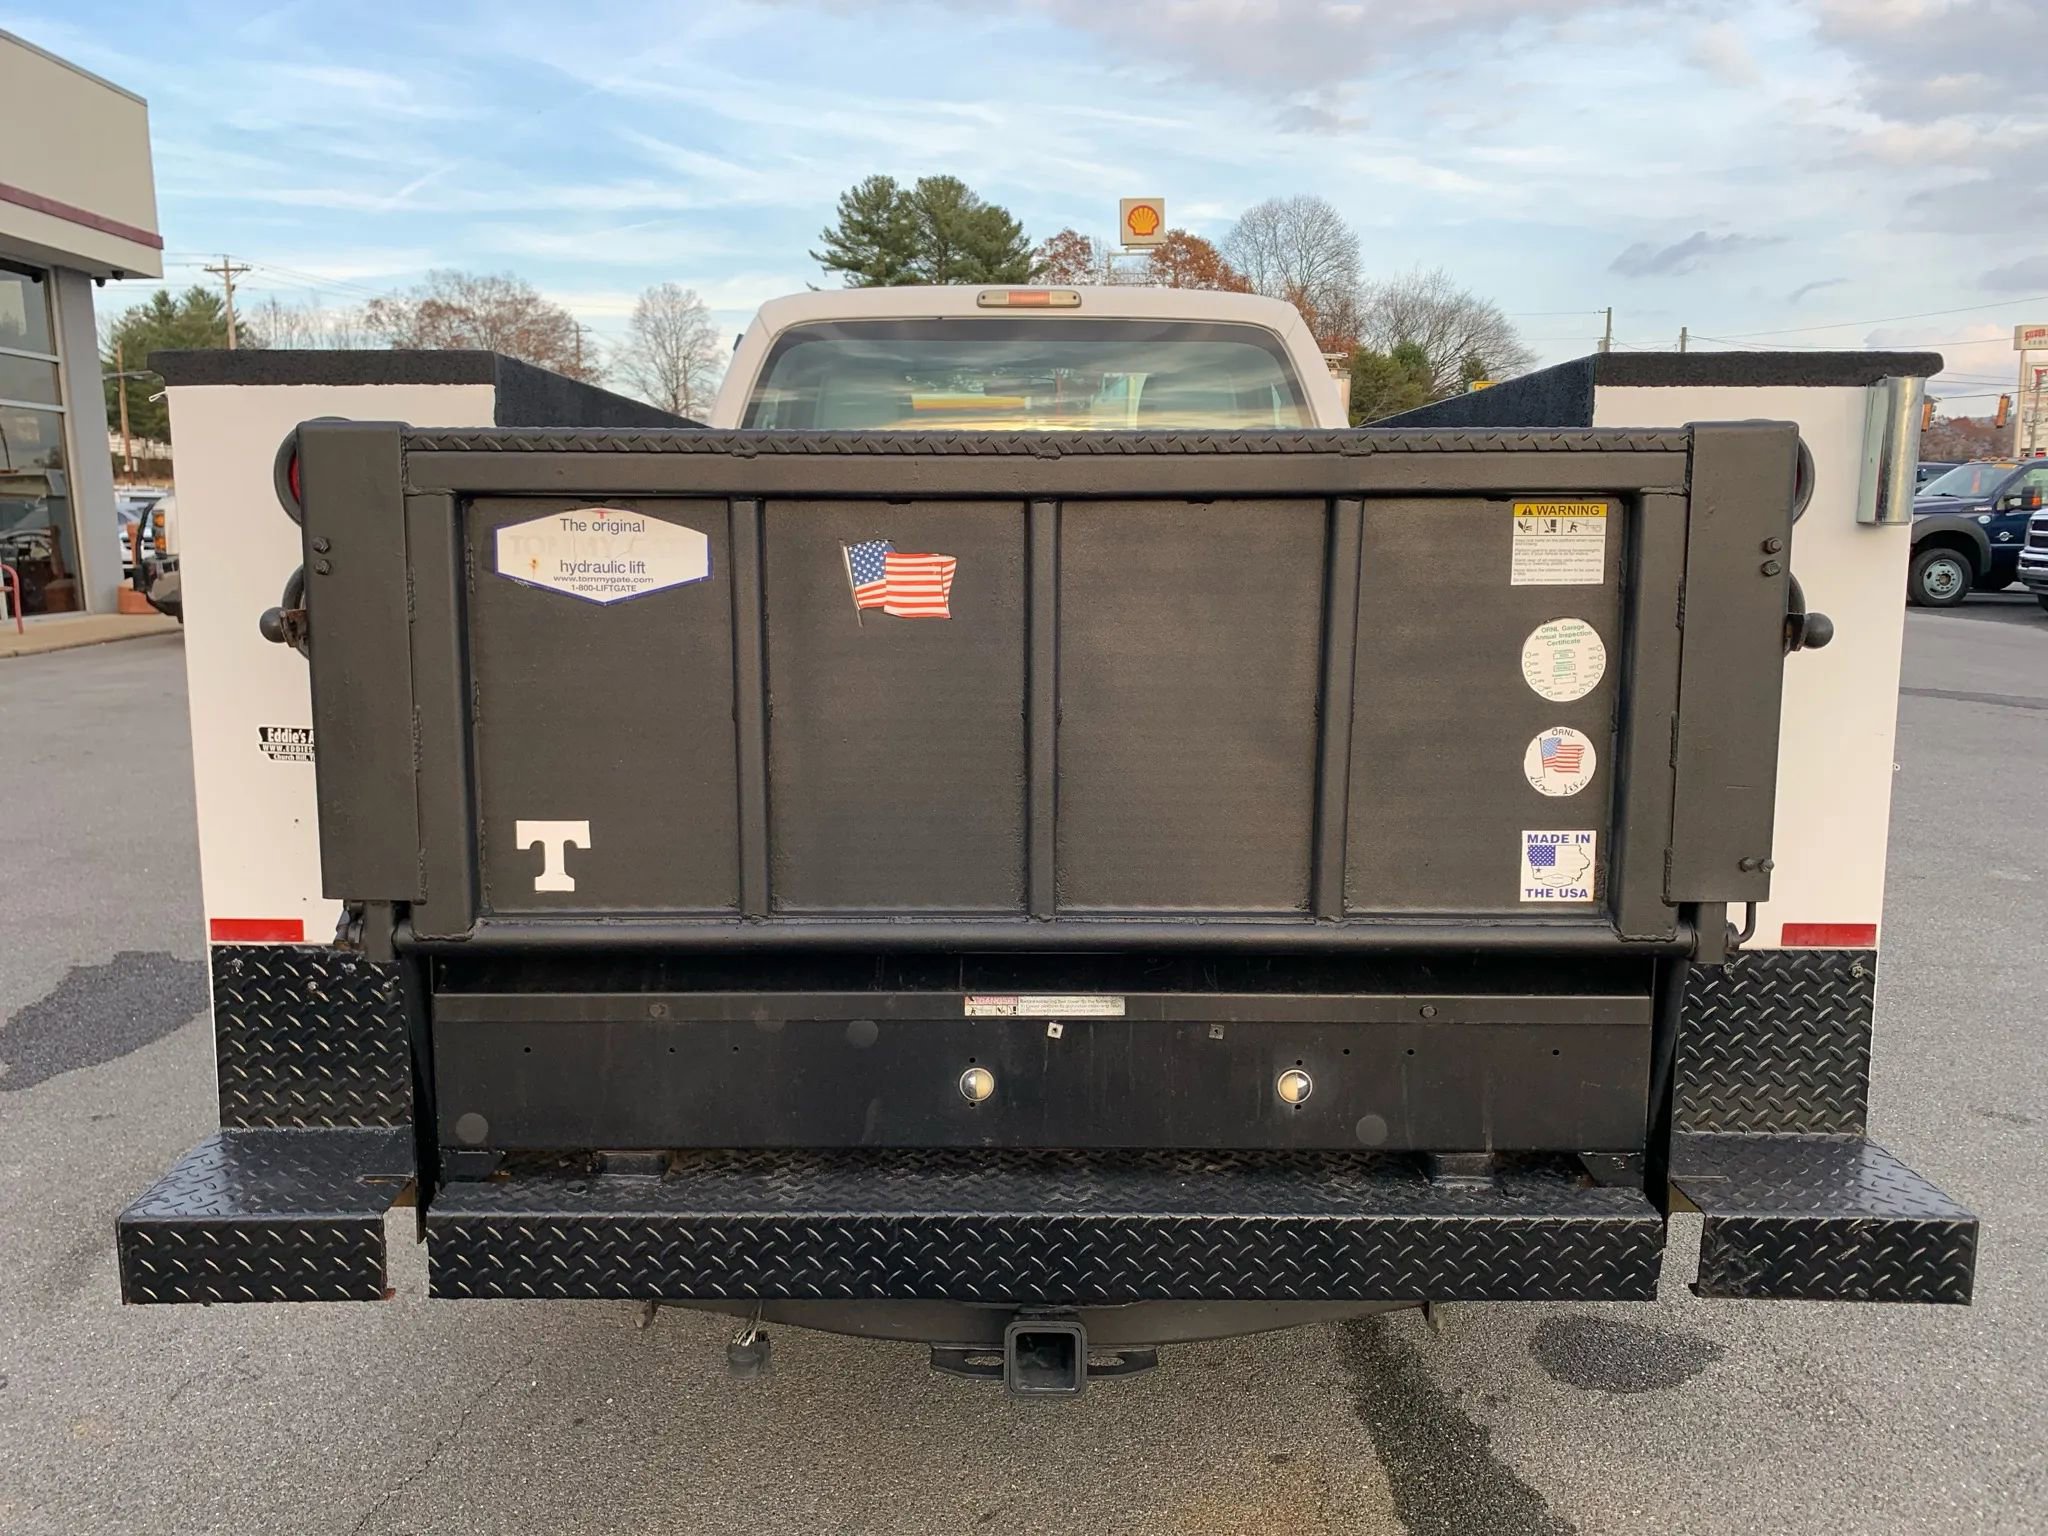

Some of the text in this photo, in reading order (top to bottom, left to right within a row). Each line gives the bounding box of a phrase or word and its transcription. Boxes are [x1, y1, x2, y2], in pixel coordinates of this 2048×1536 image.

[1536, 505, 1600, 516] WARNING
[560, 518, 645, 535] The original
[560, 559, 646, 578] hydraulic lift
[553, 575, 654, 585] www.tommygate.com
[572, 584, 637, 592] 1-800-LIFTGATE
[1562, 623, 1585, 631] Garage
[1535, 630, 1593, 641] Annual Inspection
[1547, 638, 1581, 646] Certificate
[268, 728, 306, 743] Eddie's
[1552, 728, 1575, 737] ORNL
[1527, 834, 1591, 843] MADE IN
[516, 820, 591, 891] T
[1525, 888, 1588, 898] THE USA
